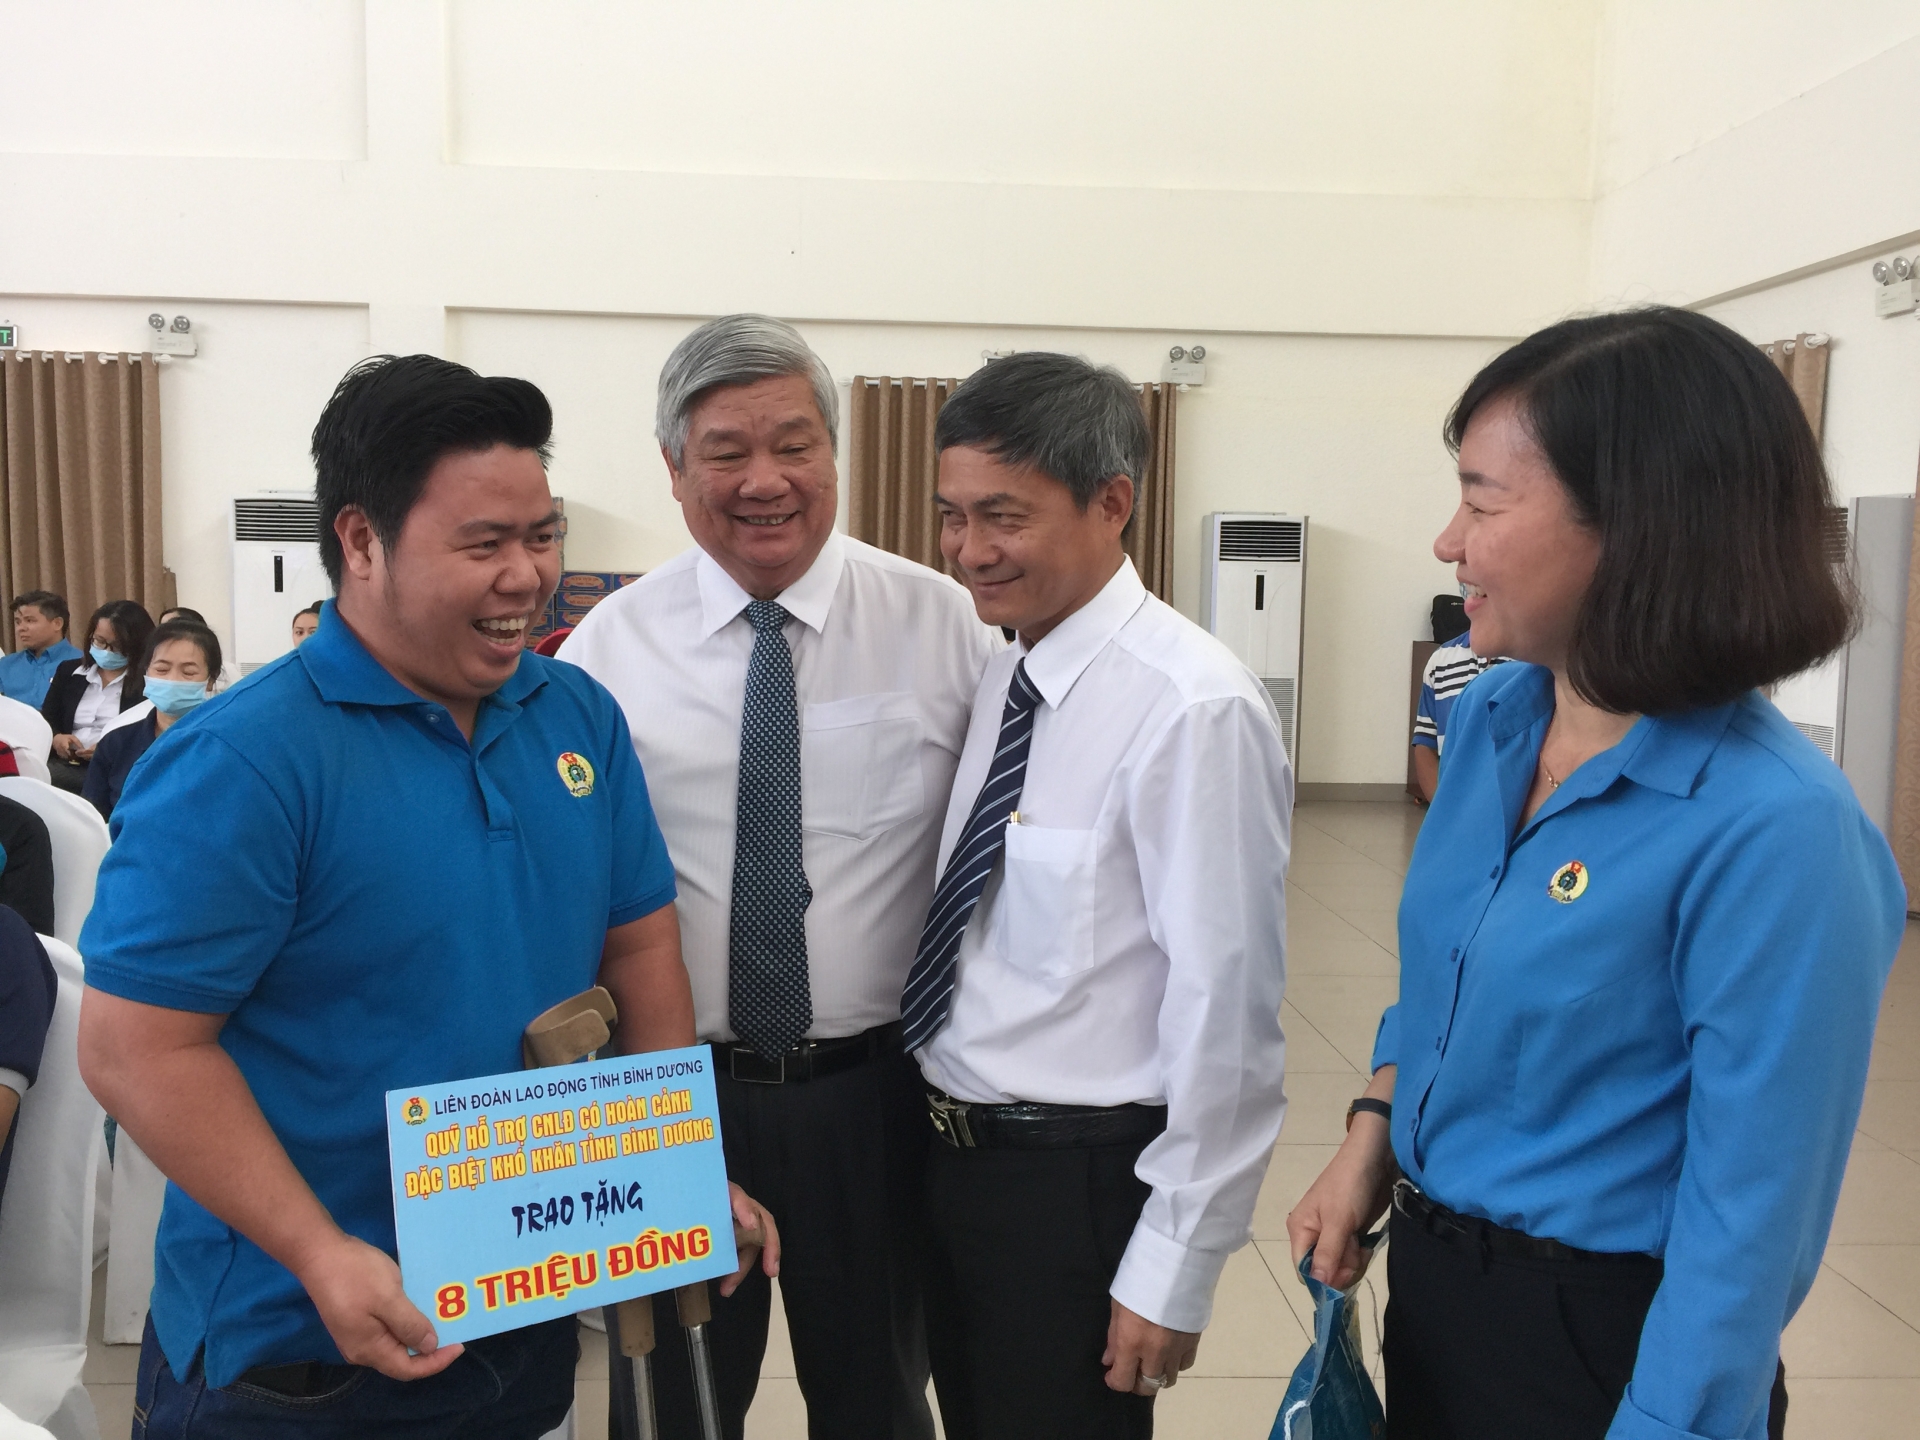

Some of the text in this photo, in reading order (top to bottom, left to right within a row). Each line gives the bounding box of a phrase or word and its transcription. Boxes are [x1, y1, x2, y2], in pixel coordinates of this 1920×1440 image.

[425, 1087, 692, 1158] QUỸ HỖ TRỢ CNLĐ CÓ HOÀN CẢNH
[434, 1094, 467, 1115] LIÊN
[471, 1087, 511, 1109] ĐOÀN
[516, 1084, 544, 1102] LAO
[547, 1078, 587, 1098] ĐỘNG
[623, 1066, 654, 1085] BÌNH
[657, 1059, 703, 1079] DƯƠNG
[405, 1117, 715, 1200] ĐẶC BIỆT KHÓ KHĂN TỈNH BÌNH DƯƠNG
[511, 1179, 643, 1239] TRAO TẶNG
[436, 1227, 711, 1319] 8 TRIỆU ĐỒNG
